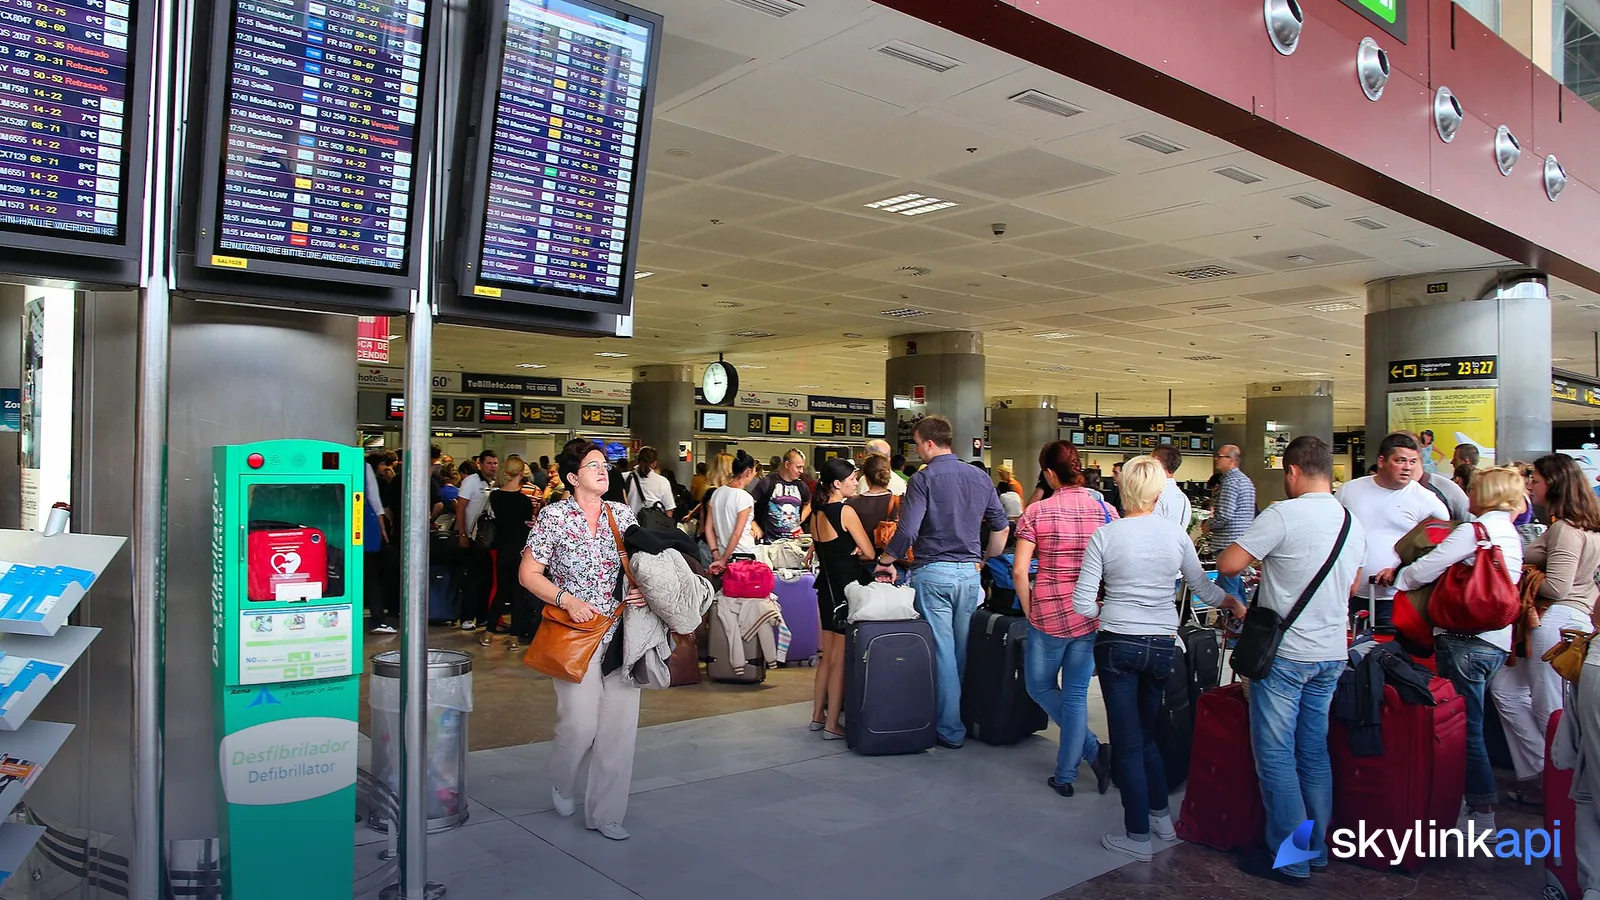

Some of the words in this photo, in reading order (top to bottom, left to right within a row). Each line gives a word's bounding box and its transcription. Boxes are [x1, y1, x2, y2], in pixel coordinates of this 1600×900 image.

[16, 0, 32, 9] 518
[0, 10, 32, 26] CX8047
[12, 30, 31, 43] 2037
[66, 42, 109, 59] Retrasado
[66, 59, 108, 75] Retrasado
[251, 66, 269, 78] Riga
[65, 77, 107, 92] Retrasado
[277, 101, 294, 111] SVO
[276, 116, 293, 126] SVO
[247, 126, 283, 139] Paderborn
[243, 186, 268, 196] London
[270, 190, 288, 199] LGW
[241, 216, 266, 226] London
[268, 219, 286, 228] LGW
[240, 231, 265, 240] London
[267, 234, 285, 242] LGW
[1429, 284, 1446, 293] C10
[378, 341, 388, 350] DE
[1457, 361, 1472, 375] 23
[1479, 360, 1495, 374] 27
[431, 404, 445, 417] 26
[456, 405, 473, 418] 27
[749, 418, 761, 430] 30
[834, 422, 845, 434] 31
[850, 423, 862, 434] 32
[211, 472, 220, 668] Desfibrilador
[230, 688, 252, 697] Aena
[230, 739, 350, 767] Desfibrilador
[248, 761, 337, 784] Defibrillator
